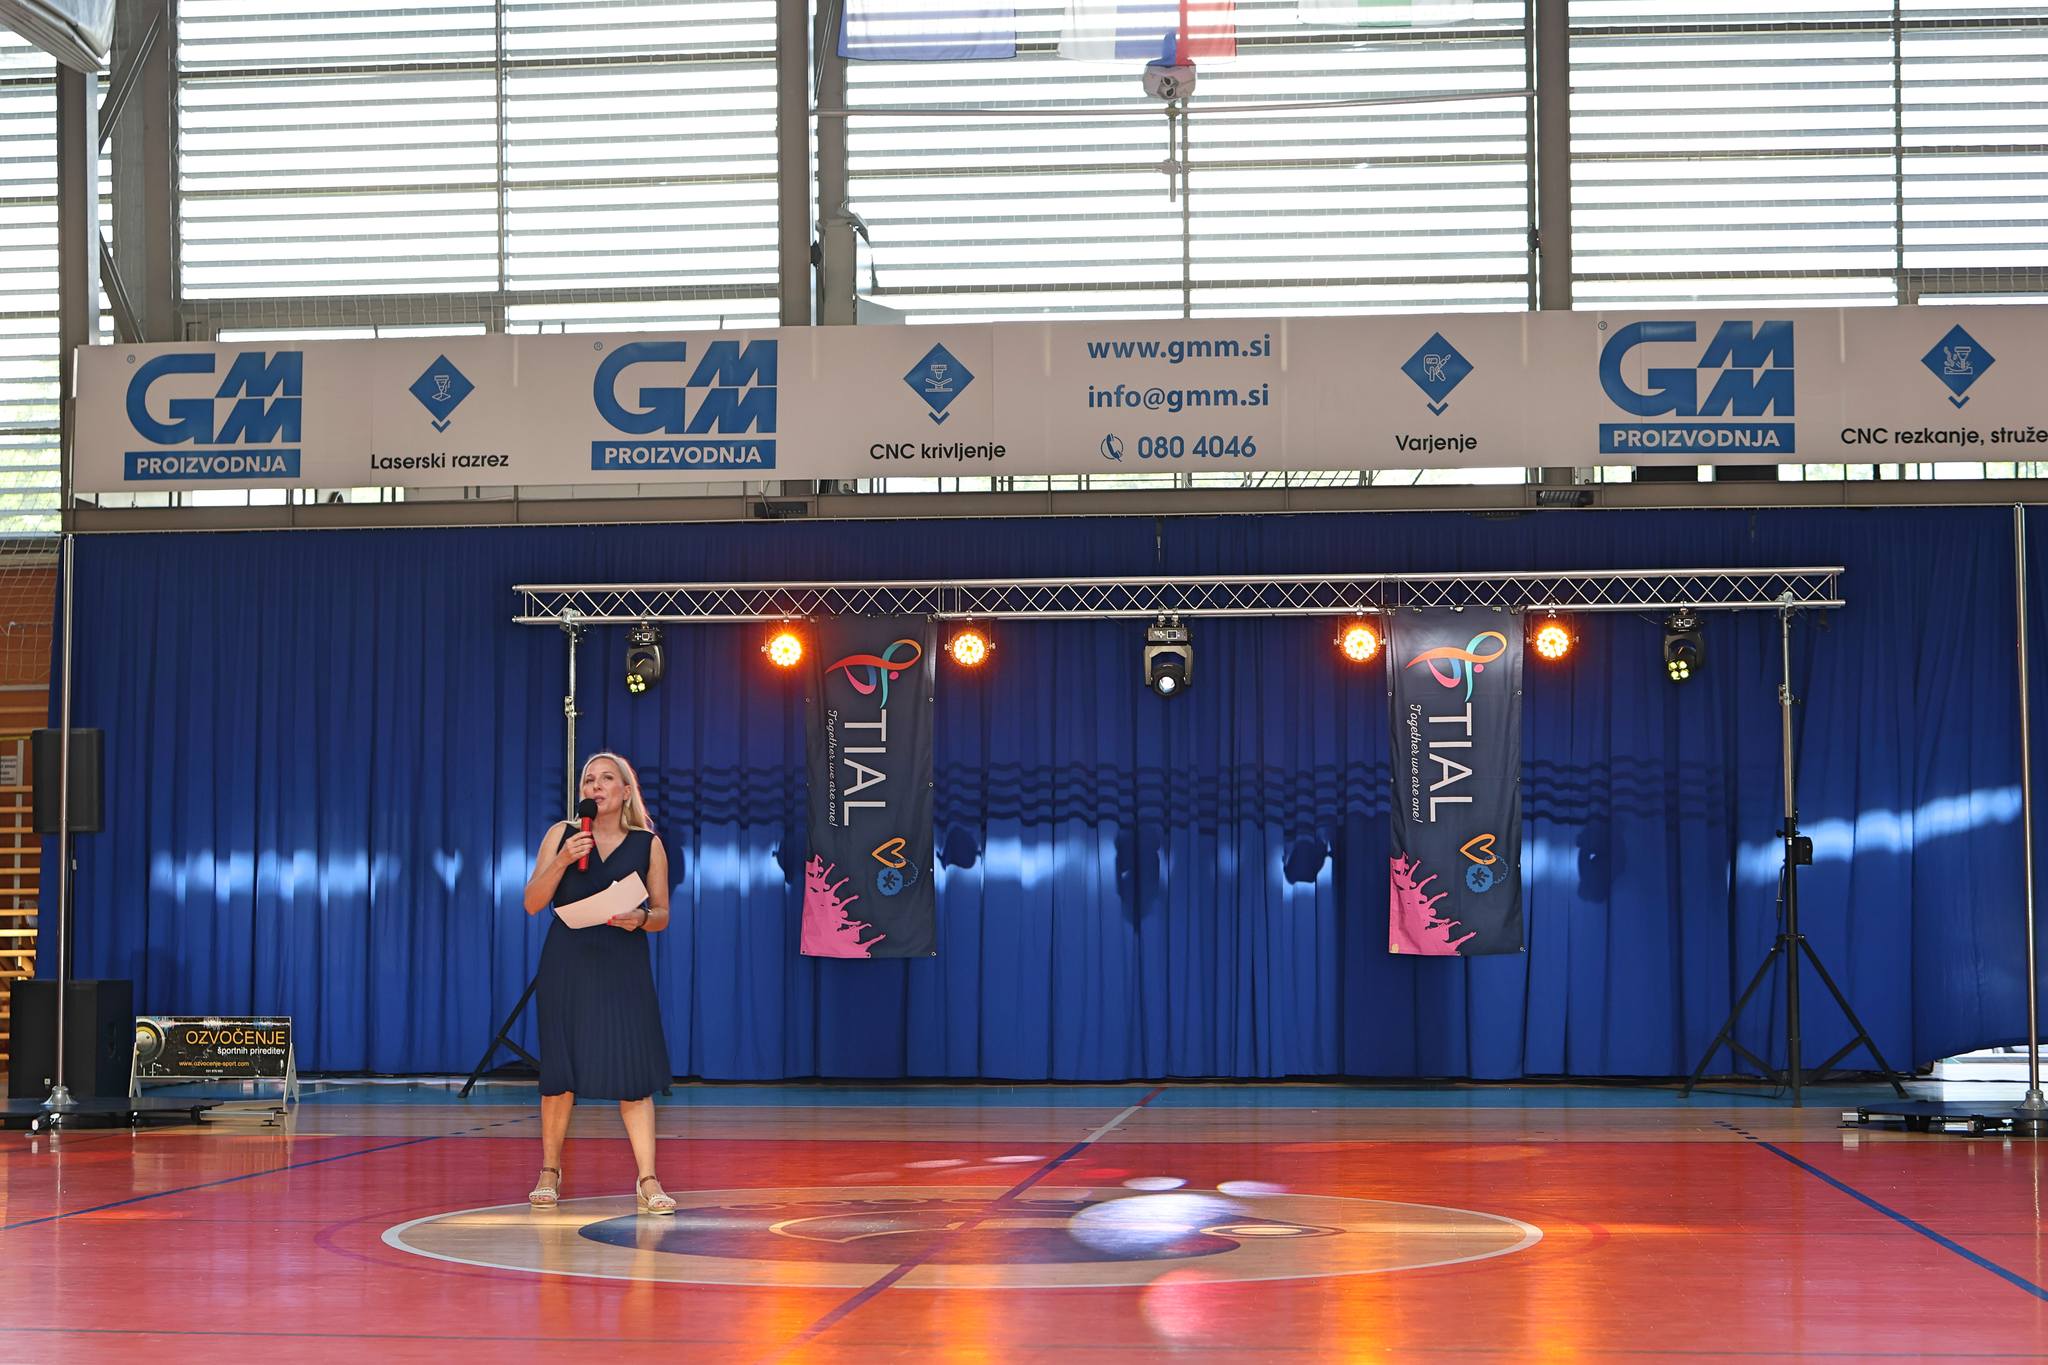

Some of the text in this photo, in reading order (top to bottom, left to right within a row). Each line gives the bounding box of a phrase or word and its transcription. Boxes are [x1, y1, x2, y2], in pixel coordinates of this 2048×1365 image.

[1087, 334, 1271, 364] www.gmm.si
[1088, 383, 1270, 413] info@gmm.si
[1137, 435, 1257, 459] 080 4046
[1395, 434, 1478, 454] Varjenje
[1613, 429, 1781, 448] PROIZVODNJA
[1841, 427, 1889, 445] CNC
[1895, 427, 1985, 447] rezkanje,
[371, 453, 509, 470] Laserski razrez
[604, 446, 762, 465] PROIZVODNJA
[869, 442, 1007, 462] CNC krivljenje
[136, 456, 287, 475] PROIZVODNJA
[826, 710, 838, 760] Together
[829, 762, 836, 780] we
[843, 708, 887, 827] TIAL
[1406, 704, 1423, 824] Together we are one!
[1428, 702, 1473, 823] TIAL
[829, 781, 837, 800] are
[185, 1028, 286, 1045] OZVOČENJE
[217, 1046, 286, 1056] športnih prireditev
